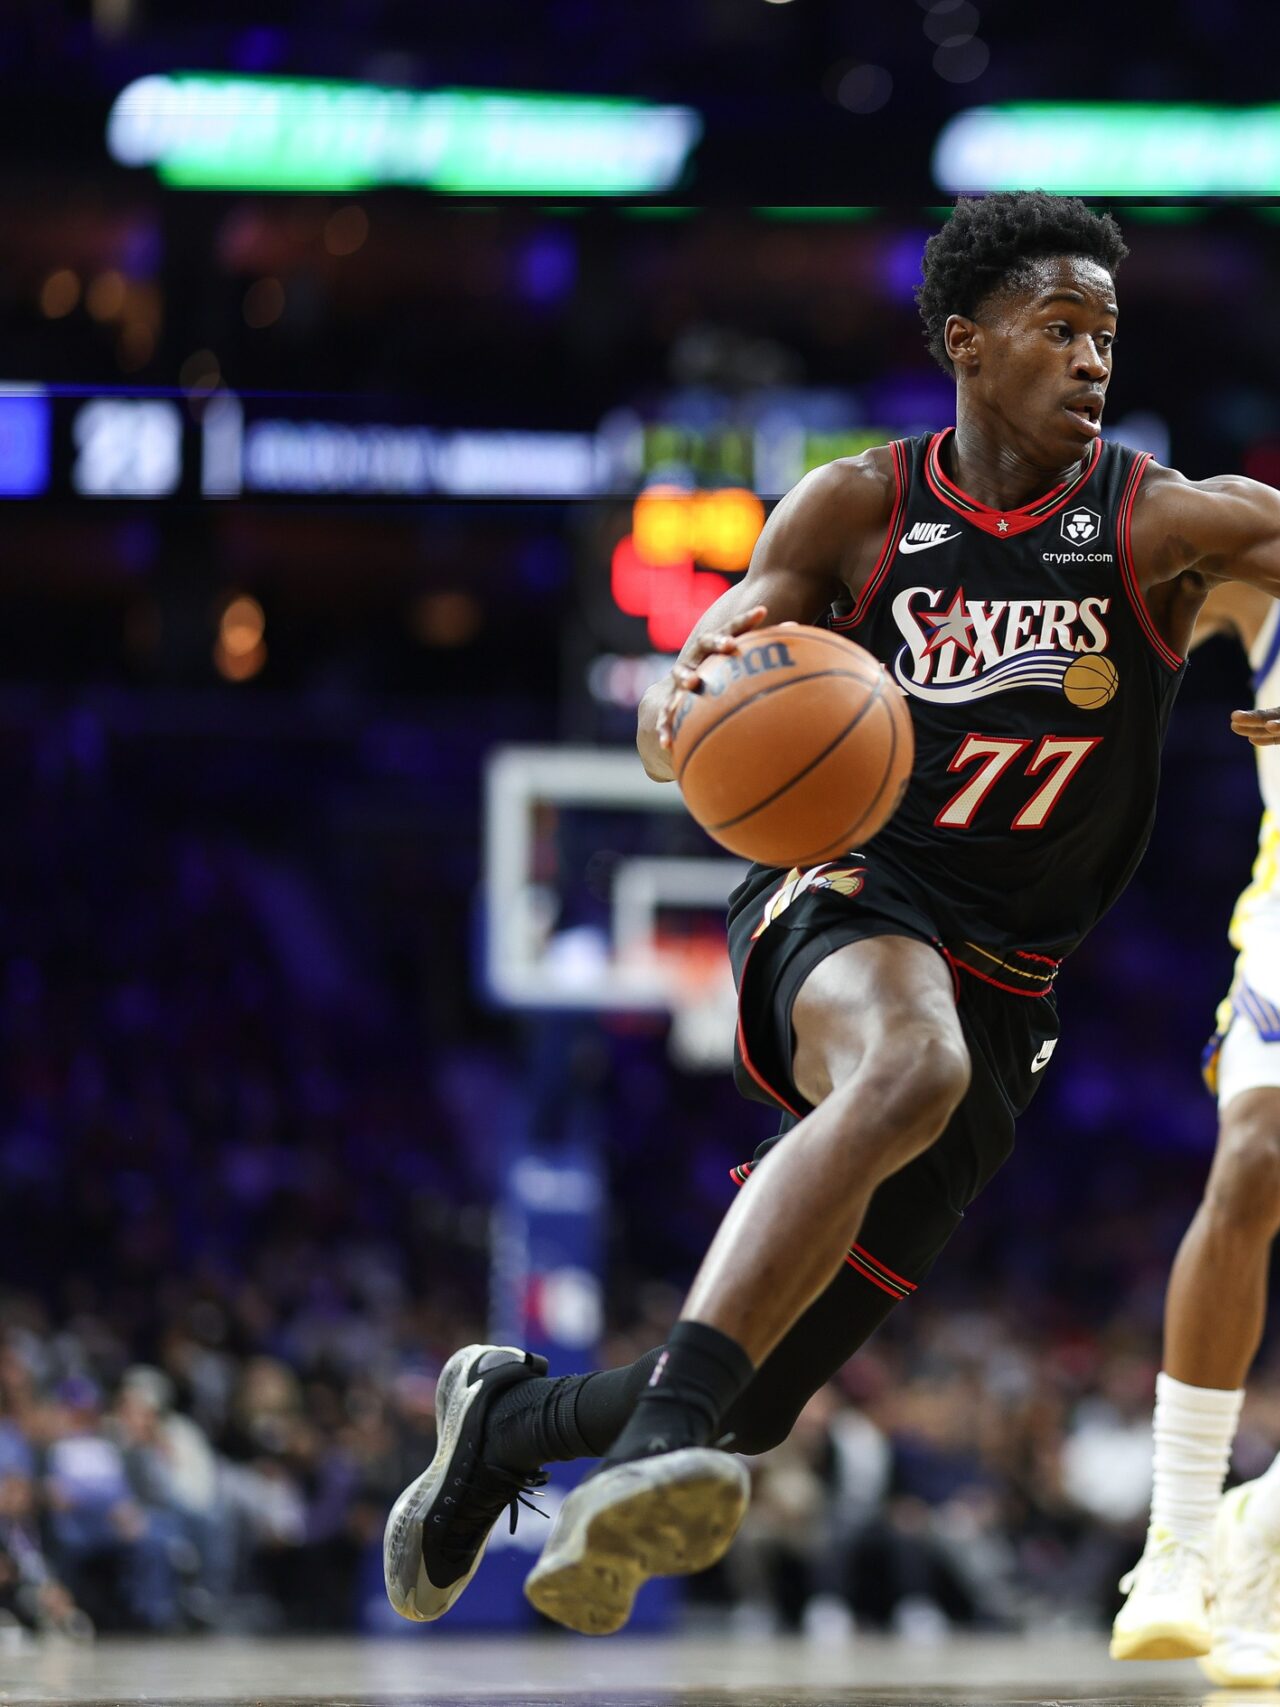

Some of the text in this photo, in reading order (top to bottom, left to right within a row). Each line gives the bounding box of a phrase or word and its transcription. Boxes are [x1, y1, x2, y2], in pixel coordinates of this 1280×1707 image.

[909, 522, 951, 543] NIKE
[1042, 551, 1113, 564] crypto.com
[934, 732, 1104, 830] 77
